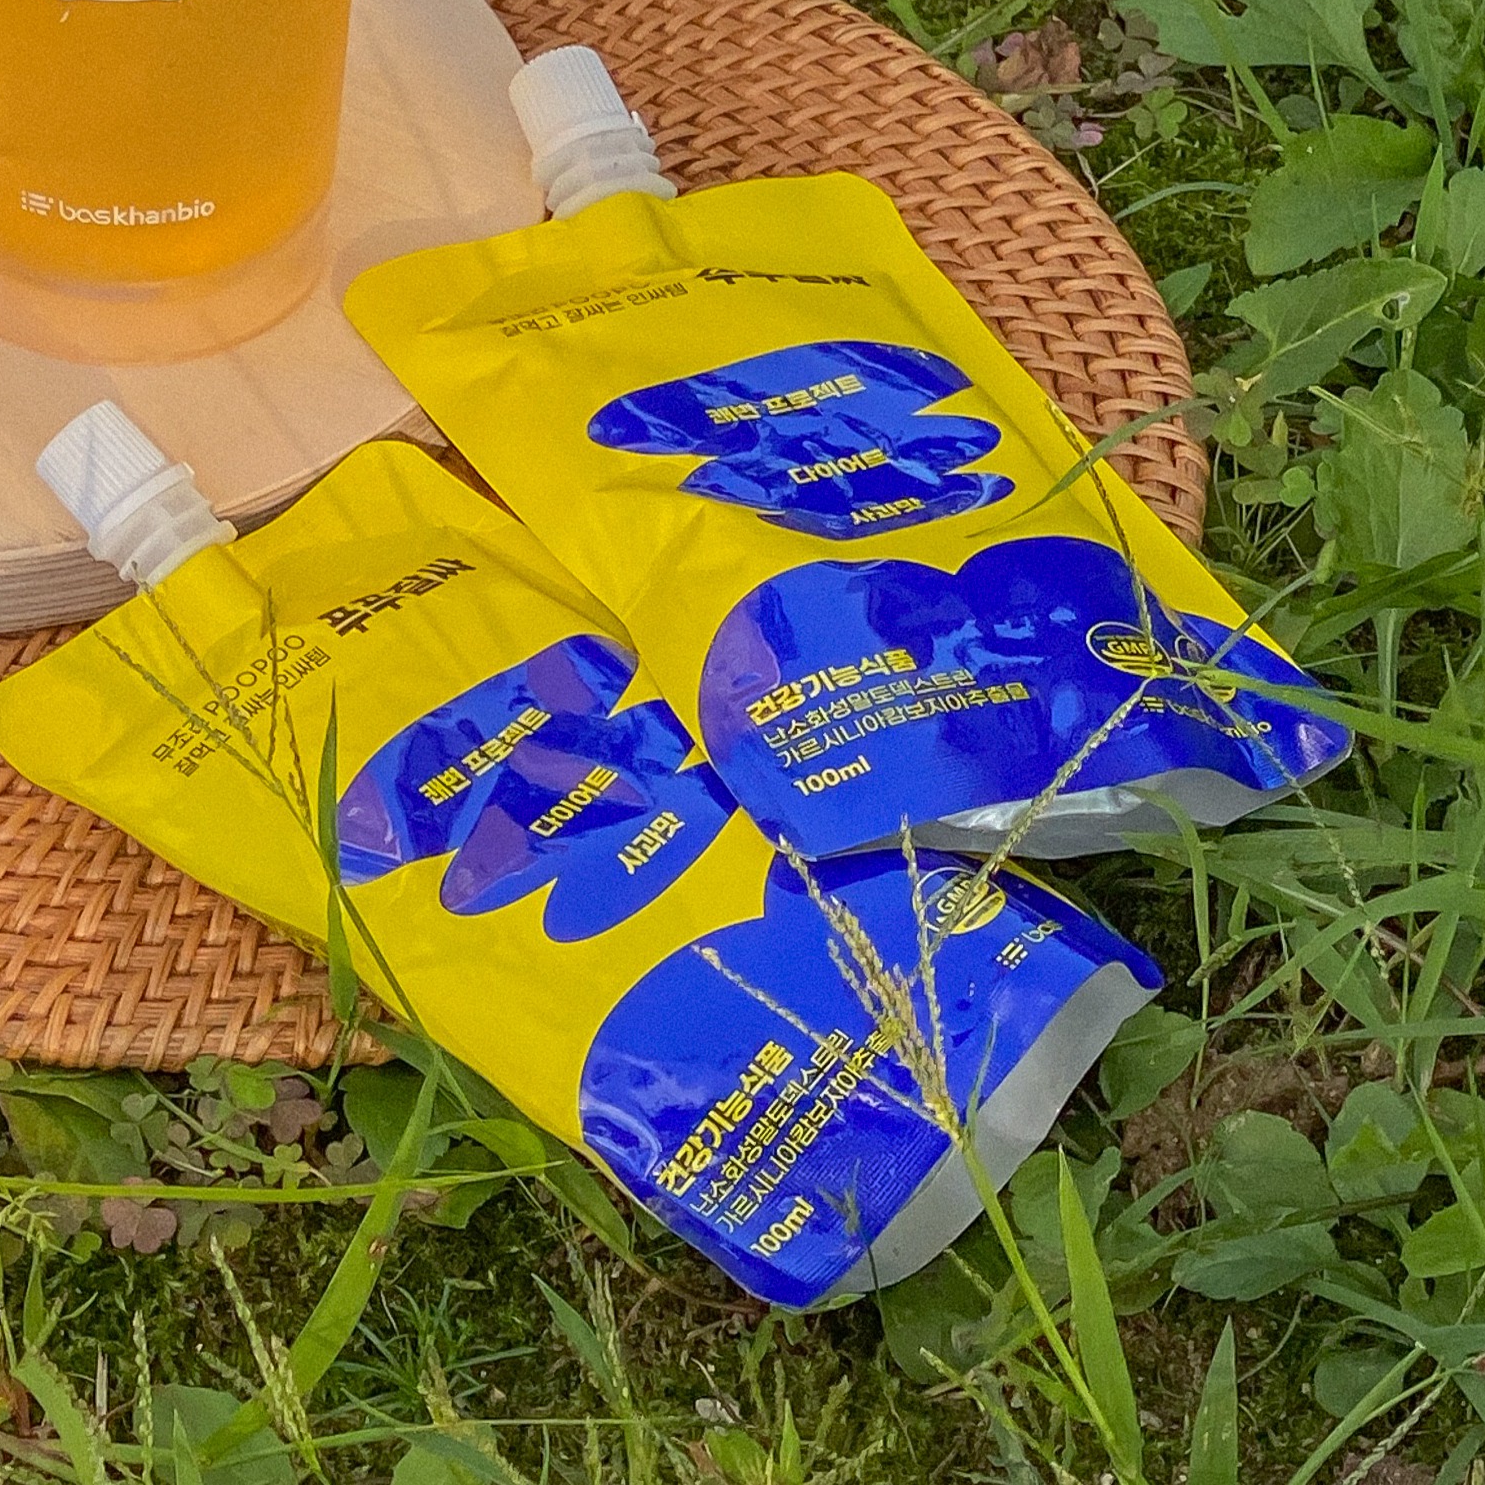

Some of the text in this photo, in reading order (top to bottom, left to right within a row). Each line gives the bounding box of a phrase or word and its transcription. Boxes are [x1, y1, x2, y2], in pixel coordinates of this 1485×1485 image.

[705, 374, 866, 424] 쾌변 프로젝트
[787, 448, 891, 485] 다이어트
[850, 497, 926, 525] 사과맛
[317, 558, 476, 637] 푸푸잘싸
[277, 646, 331, 689] 인싸템
[745, 648, 917, 727] 건강기능식품
[763, 669, 978, 749] 난소화성말토덱스트린
[418, 706, 552, 806] 쾌변 프로젝트
[792, 756, 872, 796] 100ml
[528, 765, 618, 837] 다이어트
[618, 811, 685, 875] 사과맛
[656, 1040, 794, 1197] 건강기능식품
[690, 1028, 854, 1217] 난소화성말토덱스트린
[716, 1028, 894, 1234] 가르시니아캄보지아추출
[751, 1196, 815, 1257] 100ml
